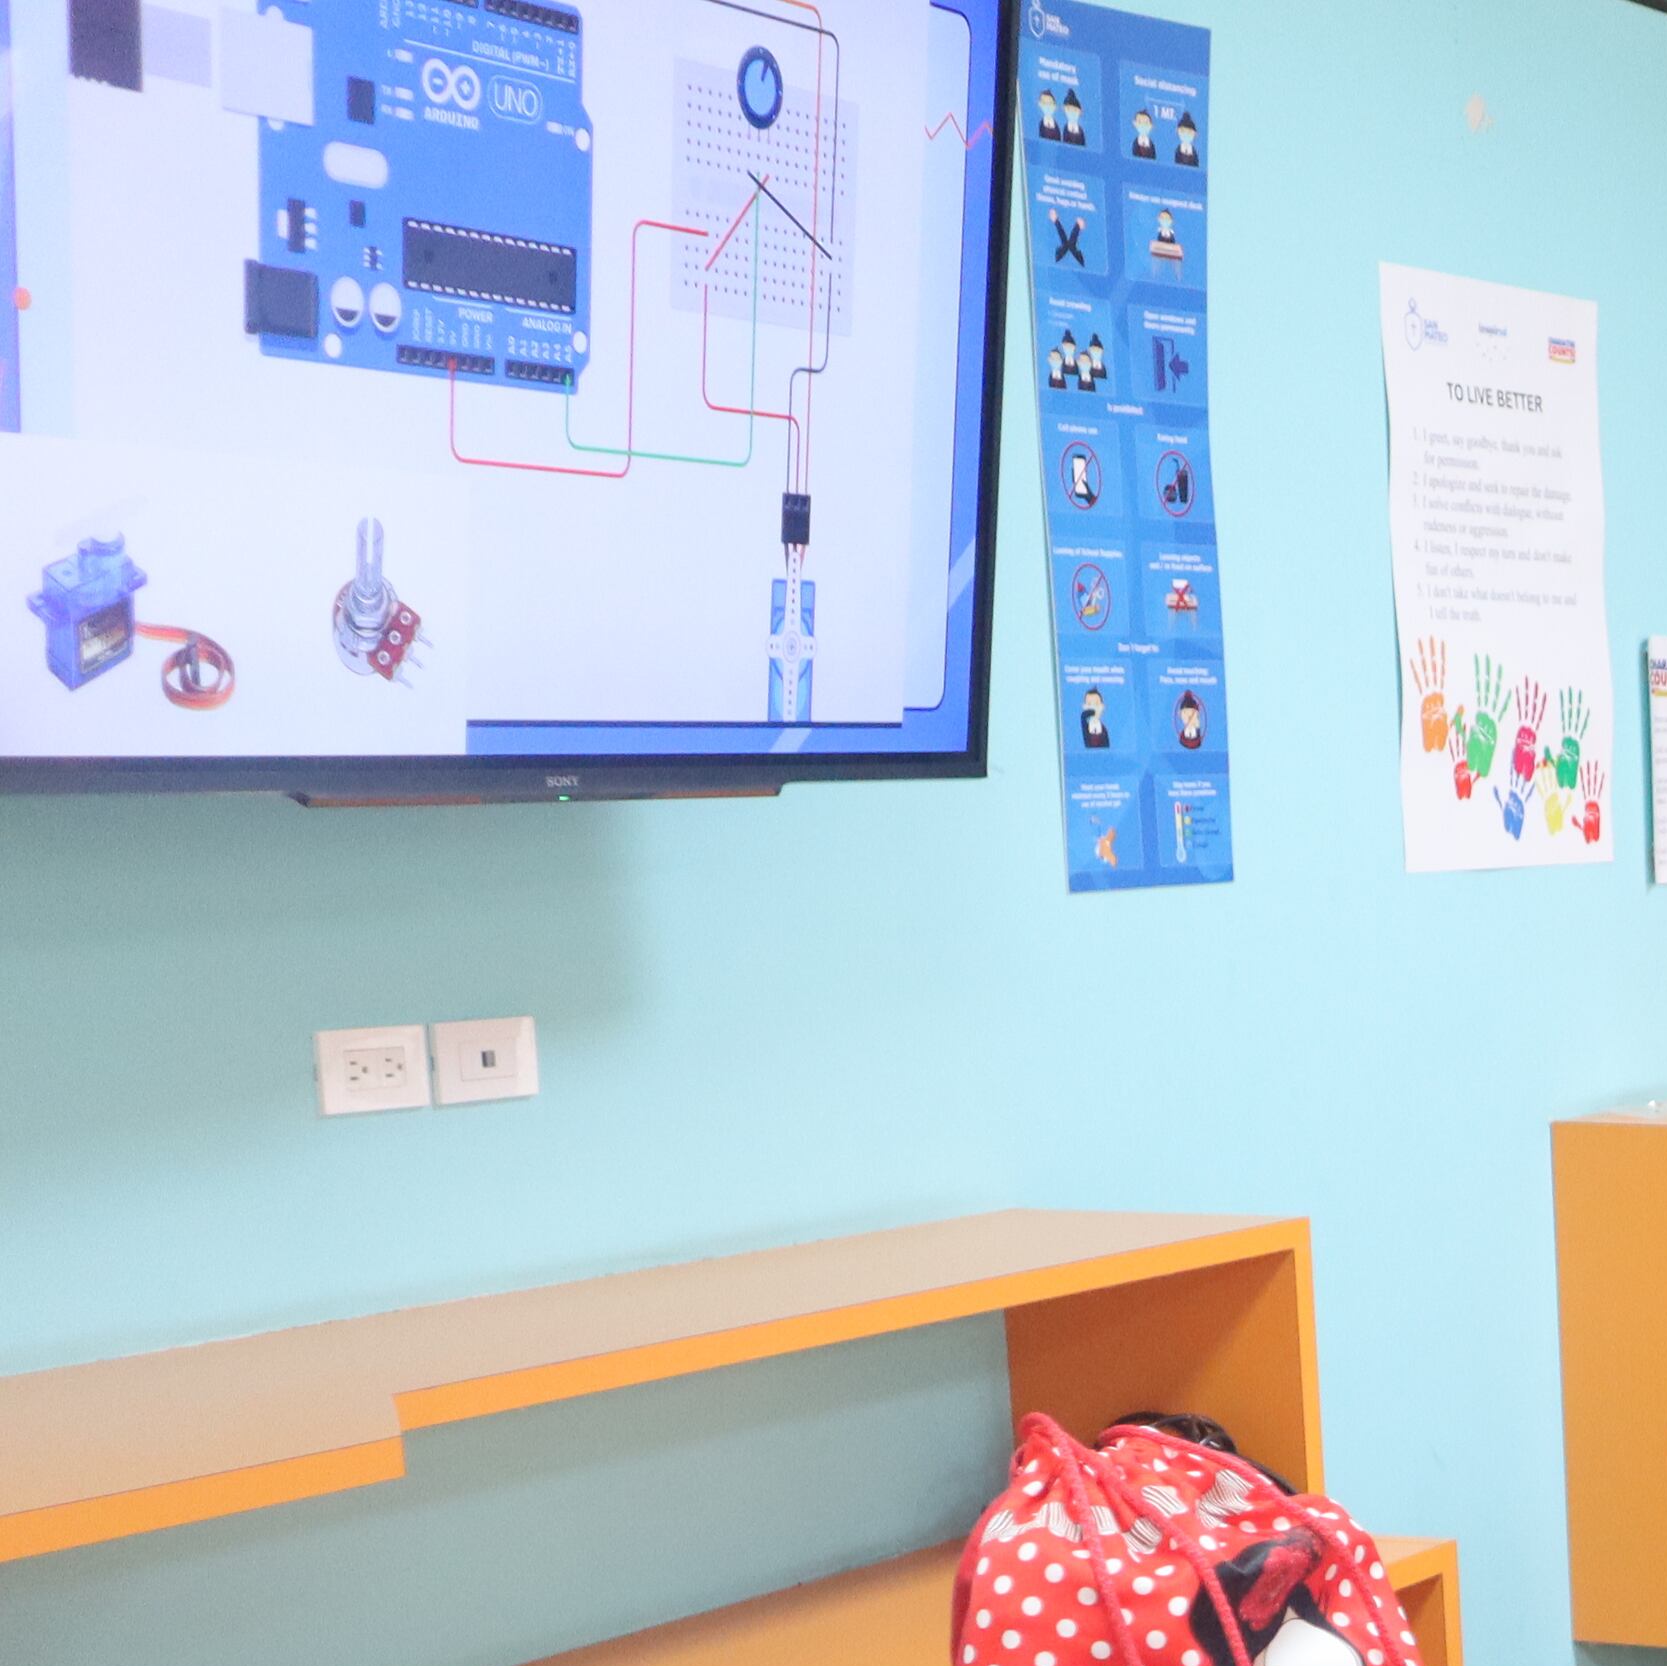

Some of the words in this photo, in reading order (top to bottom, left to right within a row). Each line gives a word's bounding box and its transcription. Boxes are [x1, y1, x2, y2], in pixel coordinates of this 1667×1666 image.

[472, 40, 511, 63] DIGITAL
[494, 81, 539, 117] UNO
[424, 106, 479, 130] ARDUINO
[458, 307, 493, 323] POWER
[522, 317, 560, 334] ANALOG
[561, 322, 572, 335] IN
[1447, 382, 1464, 402] TO
[1467, 386, 1493, 406] LIVE
[1497, 389, 1543, 412] BETTER
[545, 774, 579, 787] SONY
